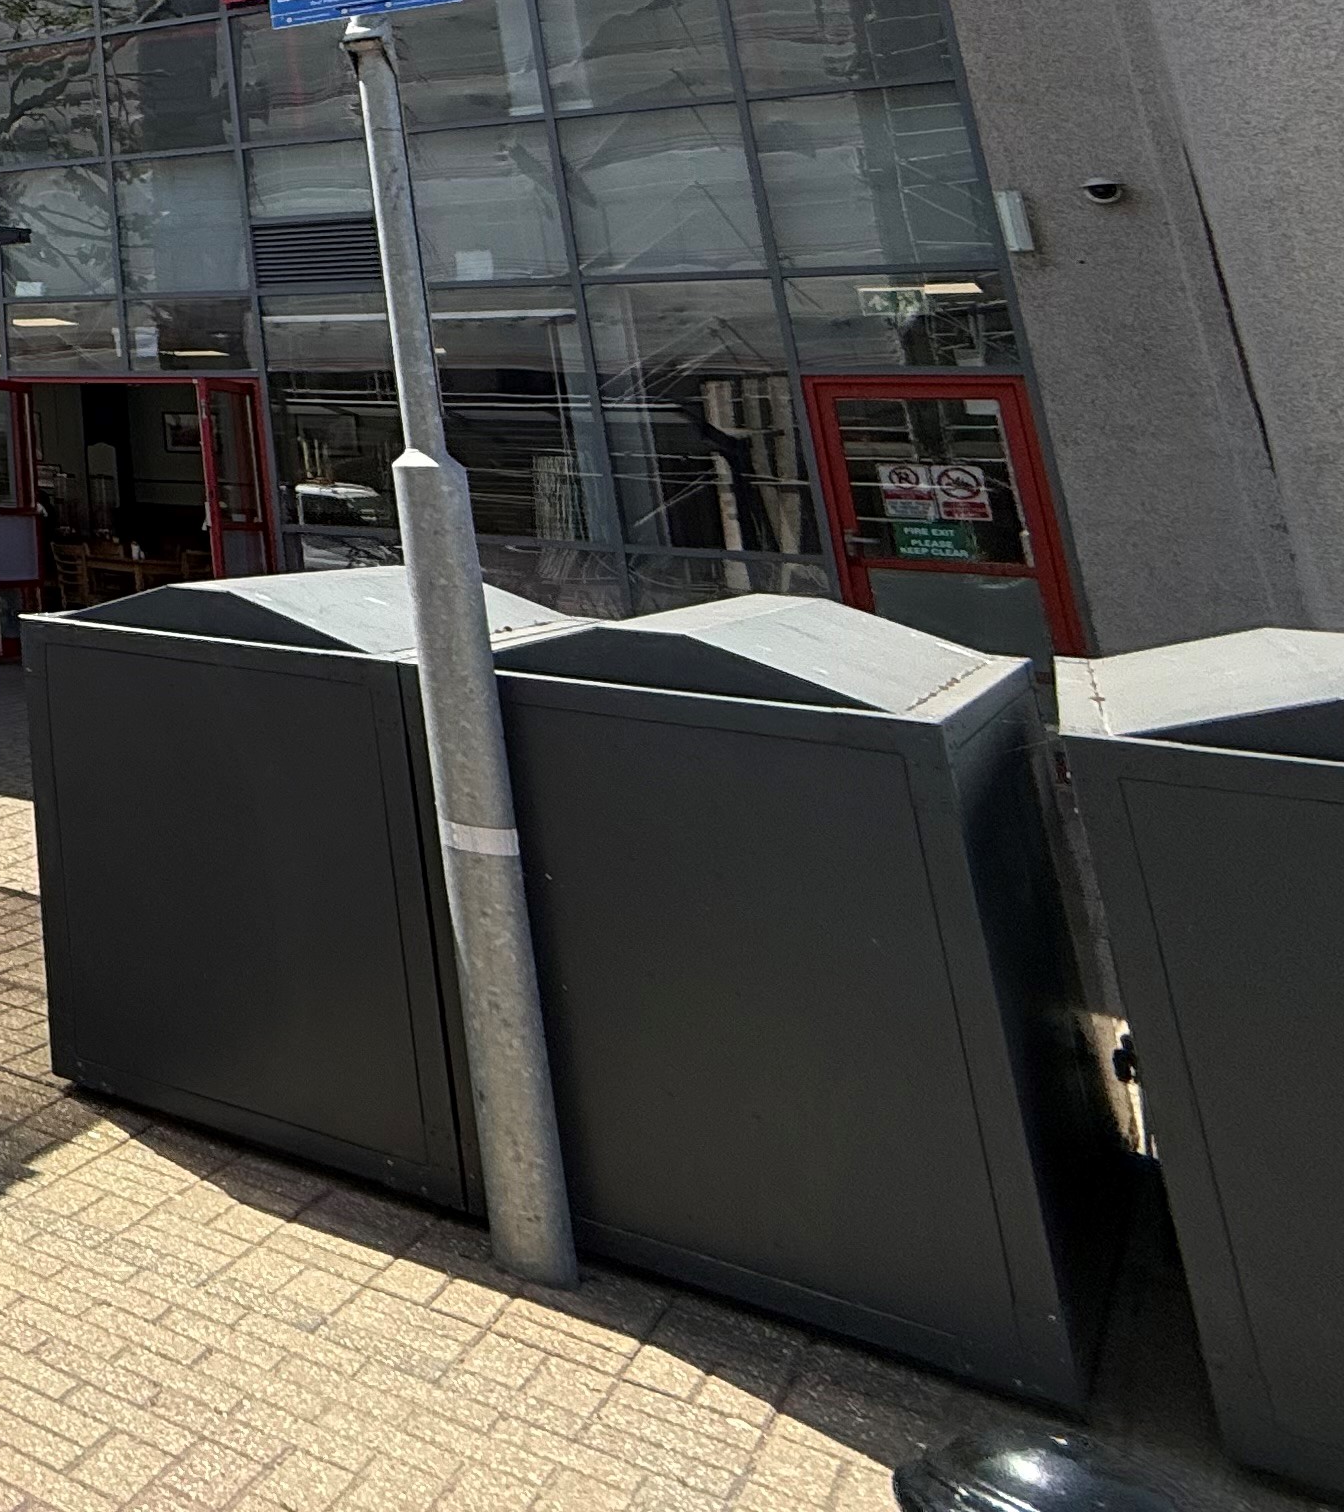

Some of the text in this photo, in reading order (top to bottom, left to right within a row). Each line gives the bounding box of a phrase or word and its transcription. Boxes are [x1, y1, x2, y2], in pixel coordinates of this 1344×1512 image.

[903, 527, 955, 537] FIRE EXIT
[910, 539, 954, 548] PLEASE
[899, 547, 969, 558] KEEP CLEAR
